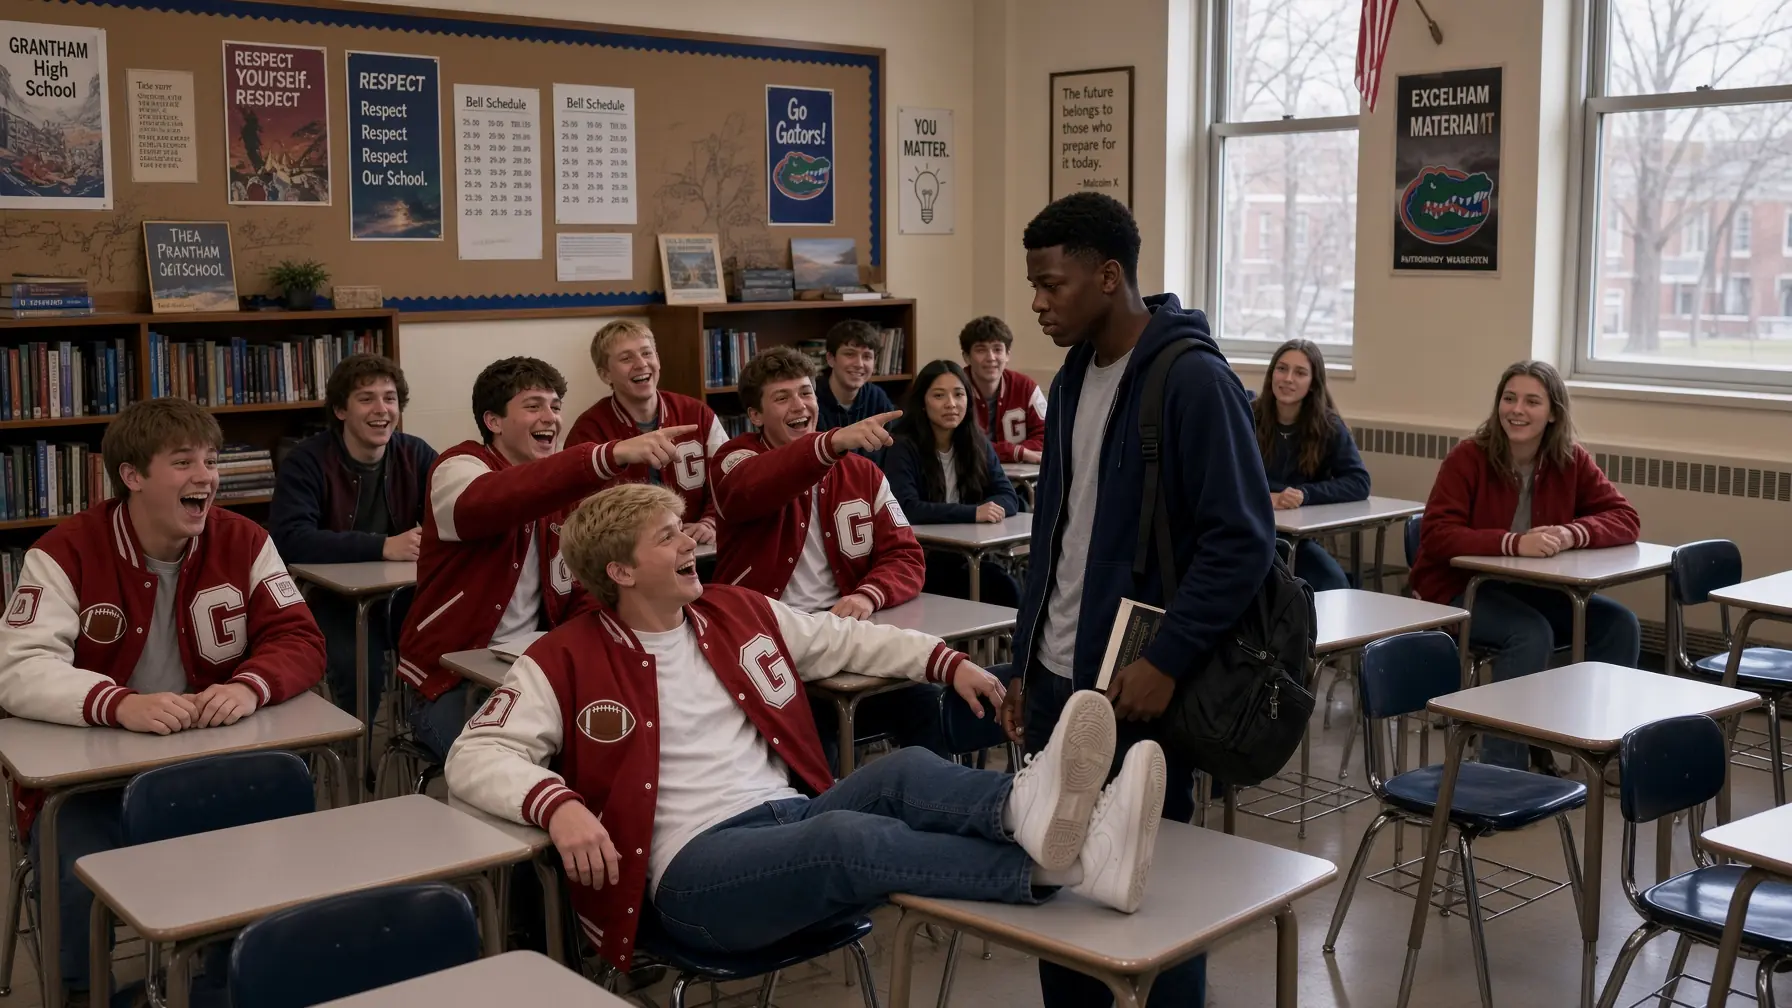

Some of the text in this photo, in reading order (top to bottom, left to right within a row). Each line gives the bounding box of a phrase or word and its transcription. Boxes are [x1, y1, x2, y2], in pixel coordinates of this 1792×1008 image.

[9, 37, 88, 59] GRANTHAM
[235, 50, 294, 68] RESPECT
[34, 60, 68, 81] High
[25, 80, 77, 99] School
[359, 72, 426, 92] RESPECT
[1062, 86, 1114, 100] The future
[1411, 85, 1490, 108] EXCELHAM
[361, 100, 407, 121] Respect
[466, 96, 527, 110] Bell Schedule
[566, 97, 625, 111] Bell Schedule
[787, 97, 808, 121] Go
[1062, 104, 1113, 119] belongs to
[361, 124, 407, 144] Respect
[775, 121, 826, 146] Gators!
[914, 118, 937, 136] YOU
[1062, 120, 1112, 135] those who
[904, 139, 950, 158] MATTER.
[1062, 137, 1116, 155] prepare for
[362, 148, 408, 167] Respect
[1062, 156, 1102, 171] it today.
[362, 170, 428, 187] Our School.
[1113, 177, 1119, 187] X
[169, 228, 201, 243] THEA
[157, 243, 220, 259] PRANTHAM
[1001, 407, 1027, 444] G
[674, 440, 706, 490] G
[833, 498, 874, 560] G
[189, 582, 249, 665] G
[738, 632, 797, 710] G
